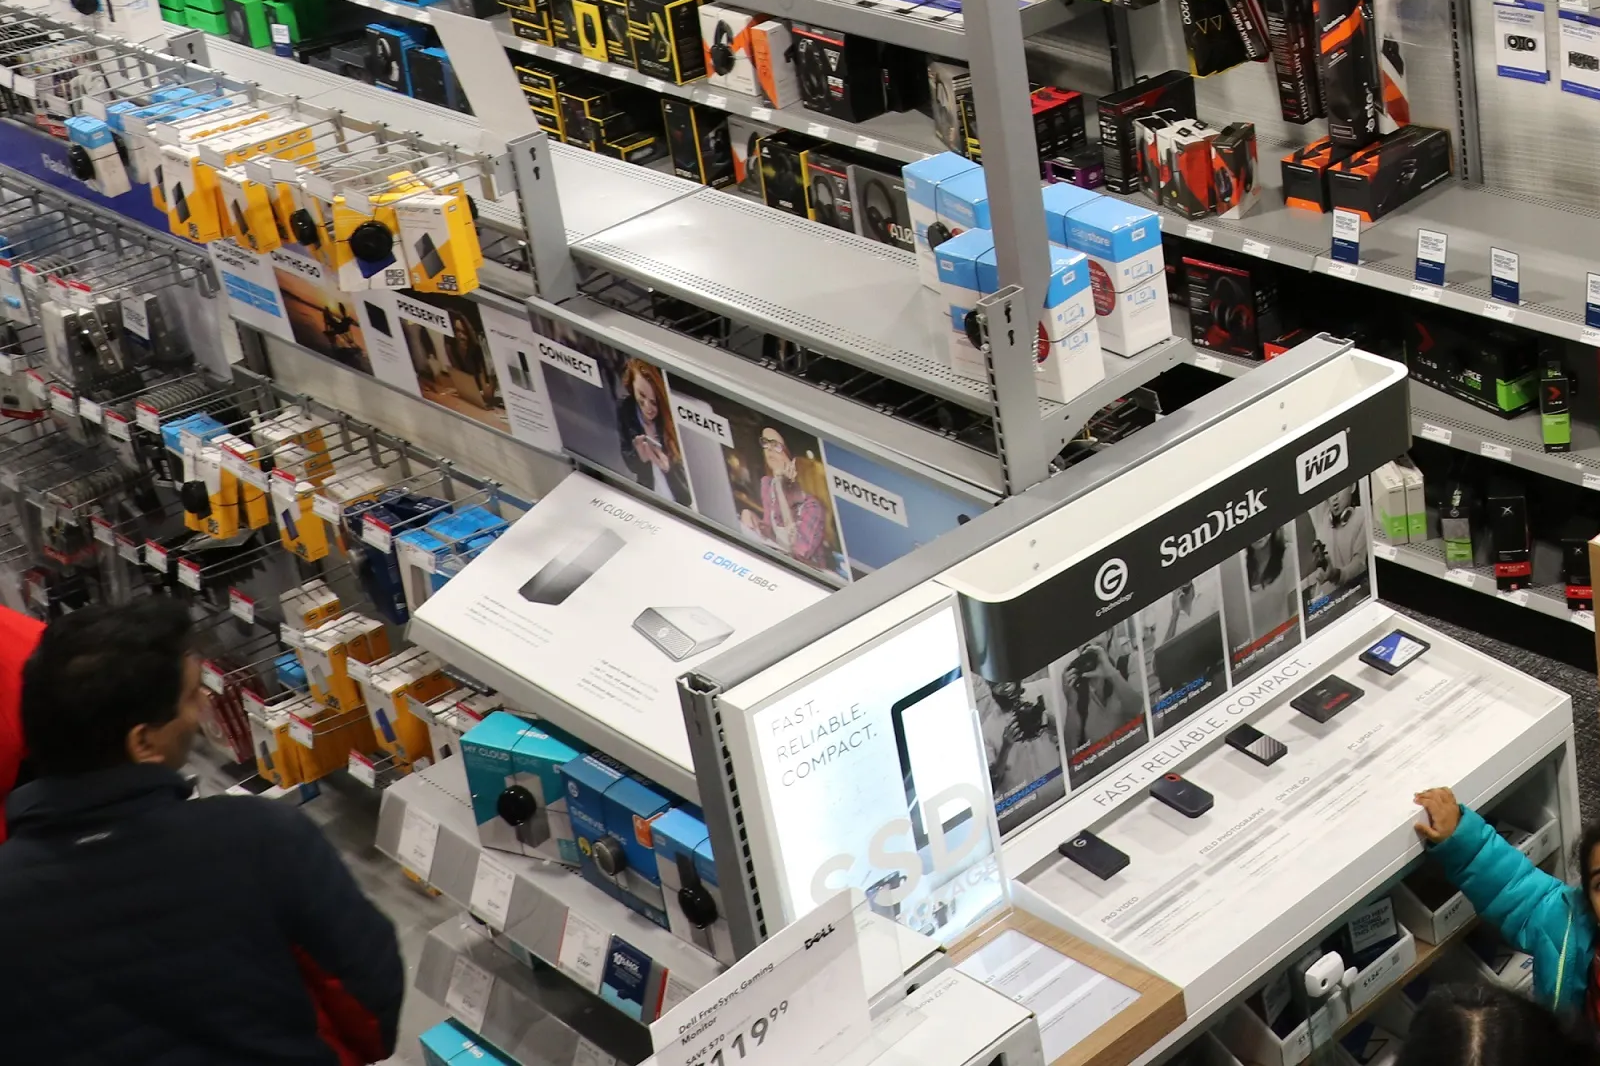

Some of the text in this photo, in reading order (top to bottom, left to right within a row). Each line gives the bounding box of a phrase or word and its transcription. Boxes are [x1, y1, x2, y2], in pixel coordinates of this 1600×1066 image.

[270, 250, 321, 279] ON-THE-GO
[397, 299, 448, 329] PRESERVE
[538, 341, 594, 377] CONNECT
[677, 403, 725, 437] CREATE
[1303, 443, 1342, 482] WD
[832, 474, 898, 514] PROTECT
[589, 496, 661, 535] MY CLOUD HOME
[1159, 486, 1268, 568] SanDisk
[747, 572, 779, 593] USB-C
[771, 699, 821, 737] FAST.
[776, 702, 867, 763] RELIABLE.
[1093, 772, 1145, 807] FAST.
[1142, 716, 1228, 775] RELIABLE.
[1225, 658, 1312, 719] COMPACT.
[781, 723, 878, 787] COMPACT.
[1096, 745, 1115, 761] speed
[811, 782, 987, 910] SSD
[1199, 807, 1267, 855] FIELD PHOTOGRAPHY
[1100, 895, 1139, 924] PRO VIDEO
[803, 923, 835, 950] DELL
[678, 962, 775, 1035] Dell FreeSync Gaming
[681, 1015, 718, 1046] Monitor
[685, 1034, 725, 1066] SAVE $70
